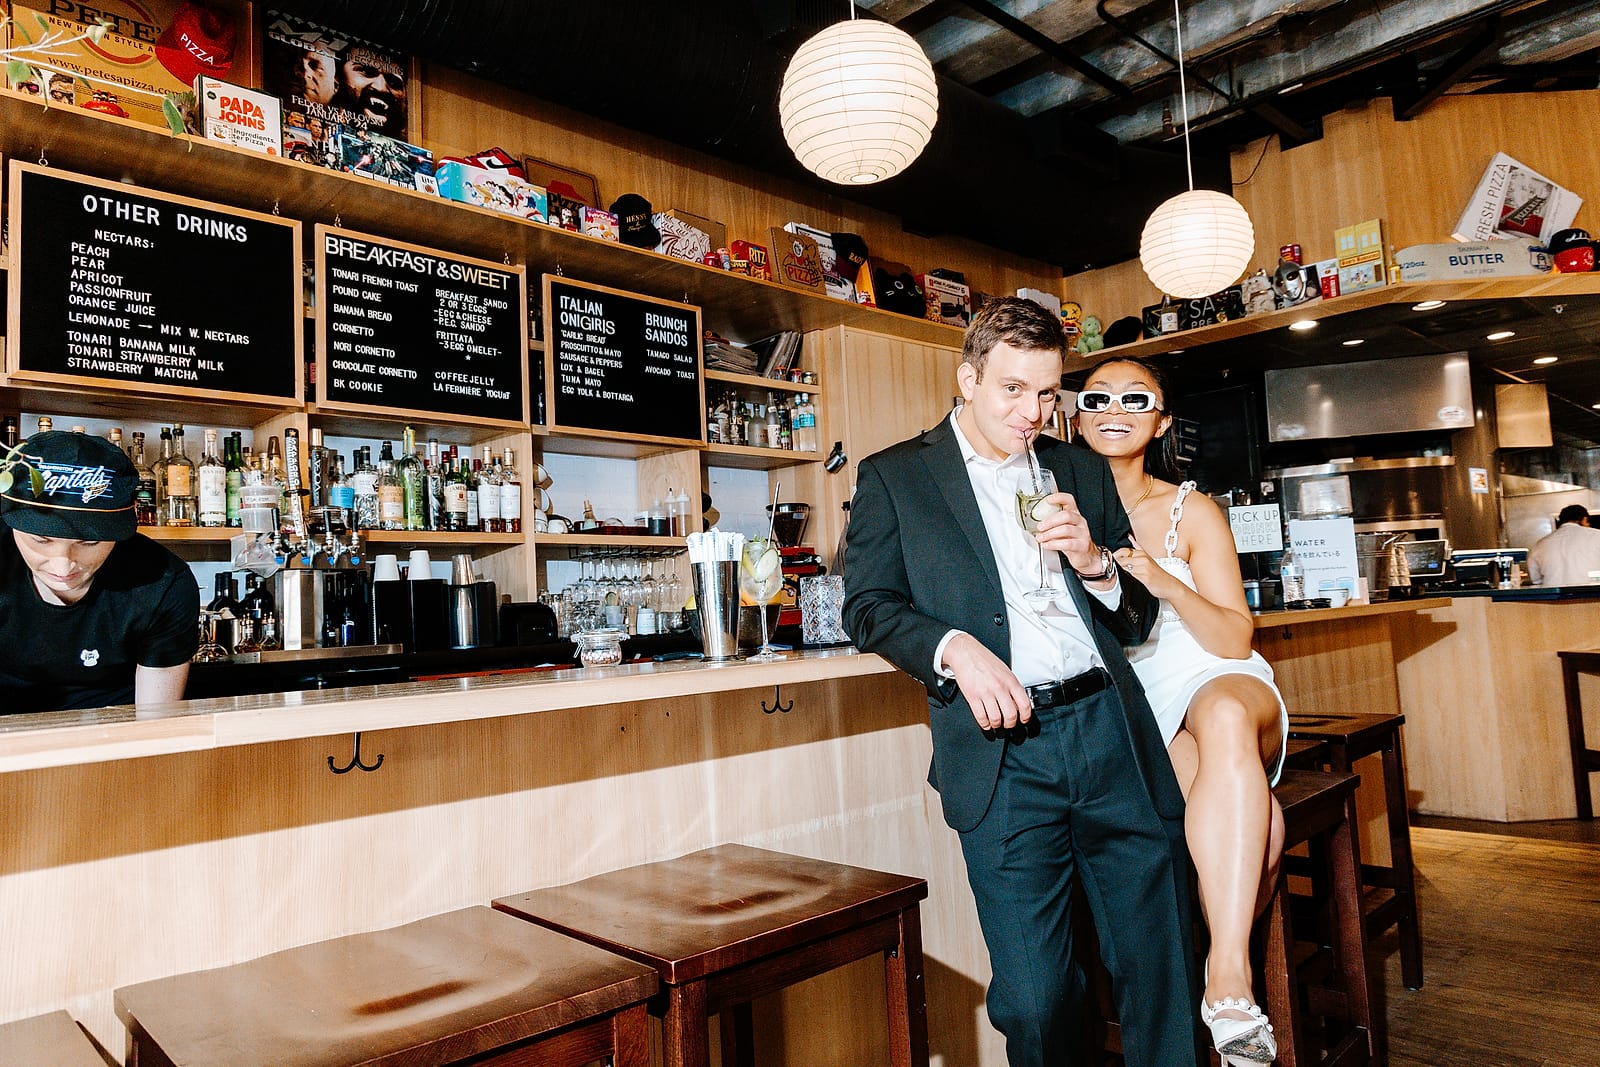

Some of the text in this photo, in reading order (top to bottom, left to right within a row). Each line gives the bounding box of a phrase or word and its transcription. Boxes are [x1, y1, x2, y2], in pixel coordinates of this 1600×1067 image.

[48, 17, 72, 30] NEW
[76, 25, 110, 41] HAN
[114, 36, 144, 50] STYLE
[179, 32, 215, 65] PIZZA
[220, 96, 265, 120] PAPA
[291, 95, 323, 110] FEDOR
[219, 109, 266, 131] JOHNS
[306, 105, 368, 131] JANUARY 24
[1475, 202, 1497, 241] FRESH
[1487, 163, 1508, 199] PIZZA
[82, 194, 248, 243] OTHER DRINKS
[94, 229, 155, 249] NECTARS:
[70, 242, 110, 258] PEACH
[748, 247, 767, 264] RITZ
[71, 255, 106, 271] PEAR
[1448, 253, 1505, 266] BUTTER
[70, 268, 124, 286] APRICOT
[331, 267, 419, 293] TONARI FRENCH TOAST
[70, 281, 152, 303] PASSIONFRUIT
[332, 285, 382, 302] POUND CAKE
[435, 288, 508, 310] BREAKFAST SANDO
[68, 294, 156, 316] ORANGE JUICE
[333, 303, 393, 322] BANANA BREAD
[440, 298, 445, 307] 2
[447, 299, 458, 310] OR
[461, 302, 467, 311] 3
[559, 295, 603, 316] ITALIAN
[68, 311, 131, 330] LEMONADE
[160, 323, 182, 337] MIX
[204, 329, 250, 345] NECTARS
[332, 322, 374, 337] CORNETTO
[460, 321, 486, 332] SANDO
[559, 311, 616, 335] ONIGIRIS
[645, 312, 688, 333] BRUNCH
[66, 330, 197, 356] TONARI BANANA MILK
[436, 330, 474, 344] FRITTATA
[645, 327, 688, 347] SANDOS
[67, 344, 225, 372] TONARI STRAWBERRY MILK
[333, 341, 395, 359] NORI CORNETTO
[559, 351, 589, 364] SAUSAGE
[646, 349, 693, 364] TAMAGO SALAD
[67, 357, 199, 381] STRAWBERRY MATCHA
[332, 360, 417, 380] CHOCOLATE CORNETTO
[560, 362, 573, 372] LOX
[584, 366, 606, 377] BAGEL
[645, 365, 695, 380] AVOCADO TOAST
[333, 378, 383, 393] BK COOKIE
[433, 382, 444, 392] LA
[434, 371, 495, 386] COFFEE JELLY
[561, 373, 602, 387] TUNA MAYO
[577, 387, 594, 397] YOLK
[602, 390, 634, 403] BOTTARGA
[1231, 510, 1279, 523] PICK UP
[1241, 533, 1273, 546] HERE
